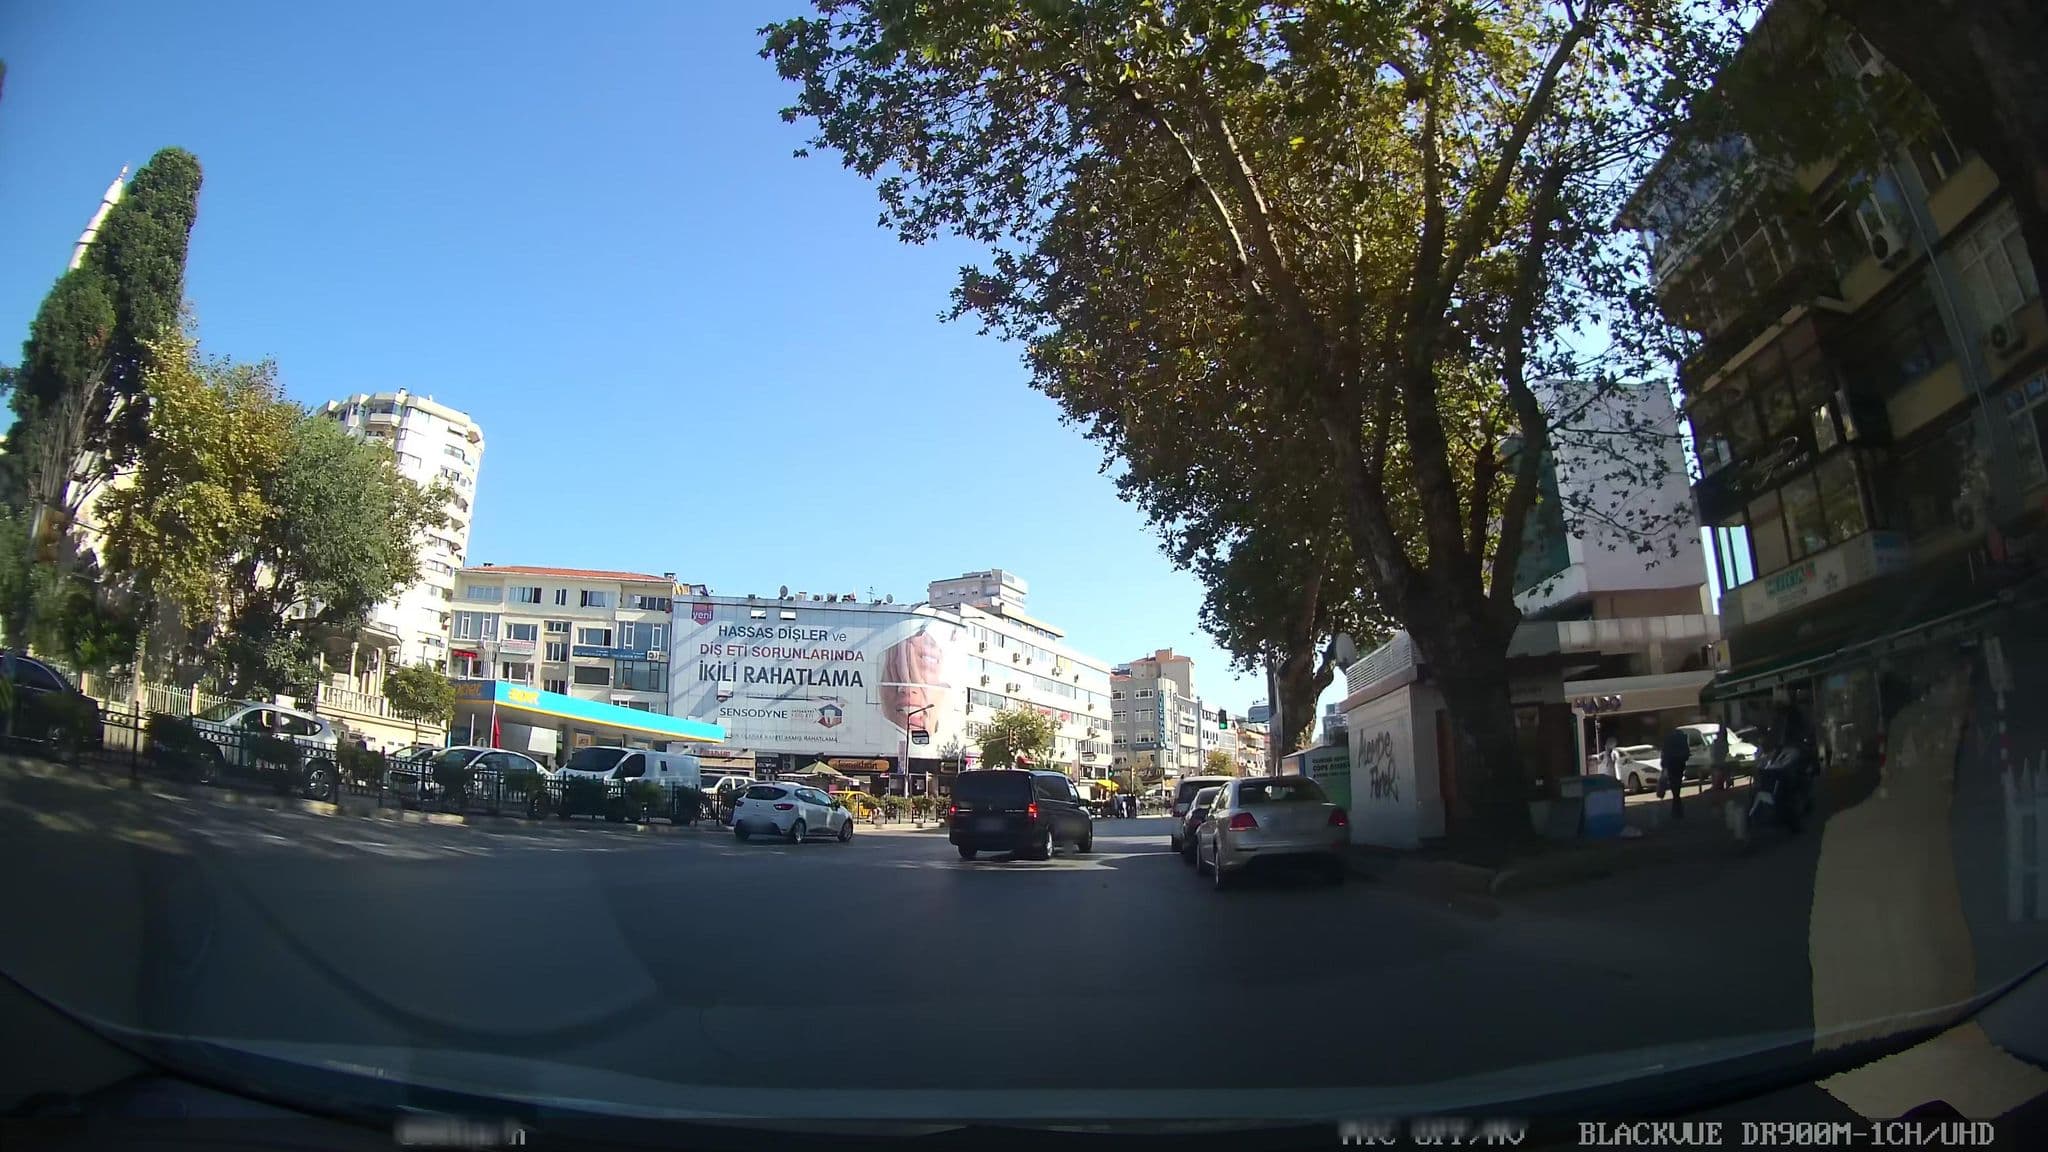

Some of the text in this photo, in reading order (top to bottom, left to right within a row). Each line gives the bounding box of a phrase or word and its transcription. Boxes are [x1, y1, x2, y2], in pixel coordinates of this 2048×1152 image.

[692, 610, 713, 620] yeni
[718, 625, 847, 642] HASSAS DİŞLER ve
[700, 641, 865, 662] DİŞ ETİ SORUNLARINDA
[699, 660, 864, 687] İKİLİ RAHATLAMA
[719, 707, 788, 719] SENSODYNE
